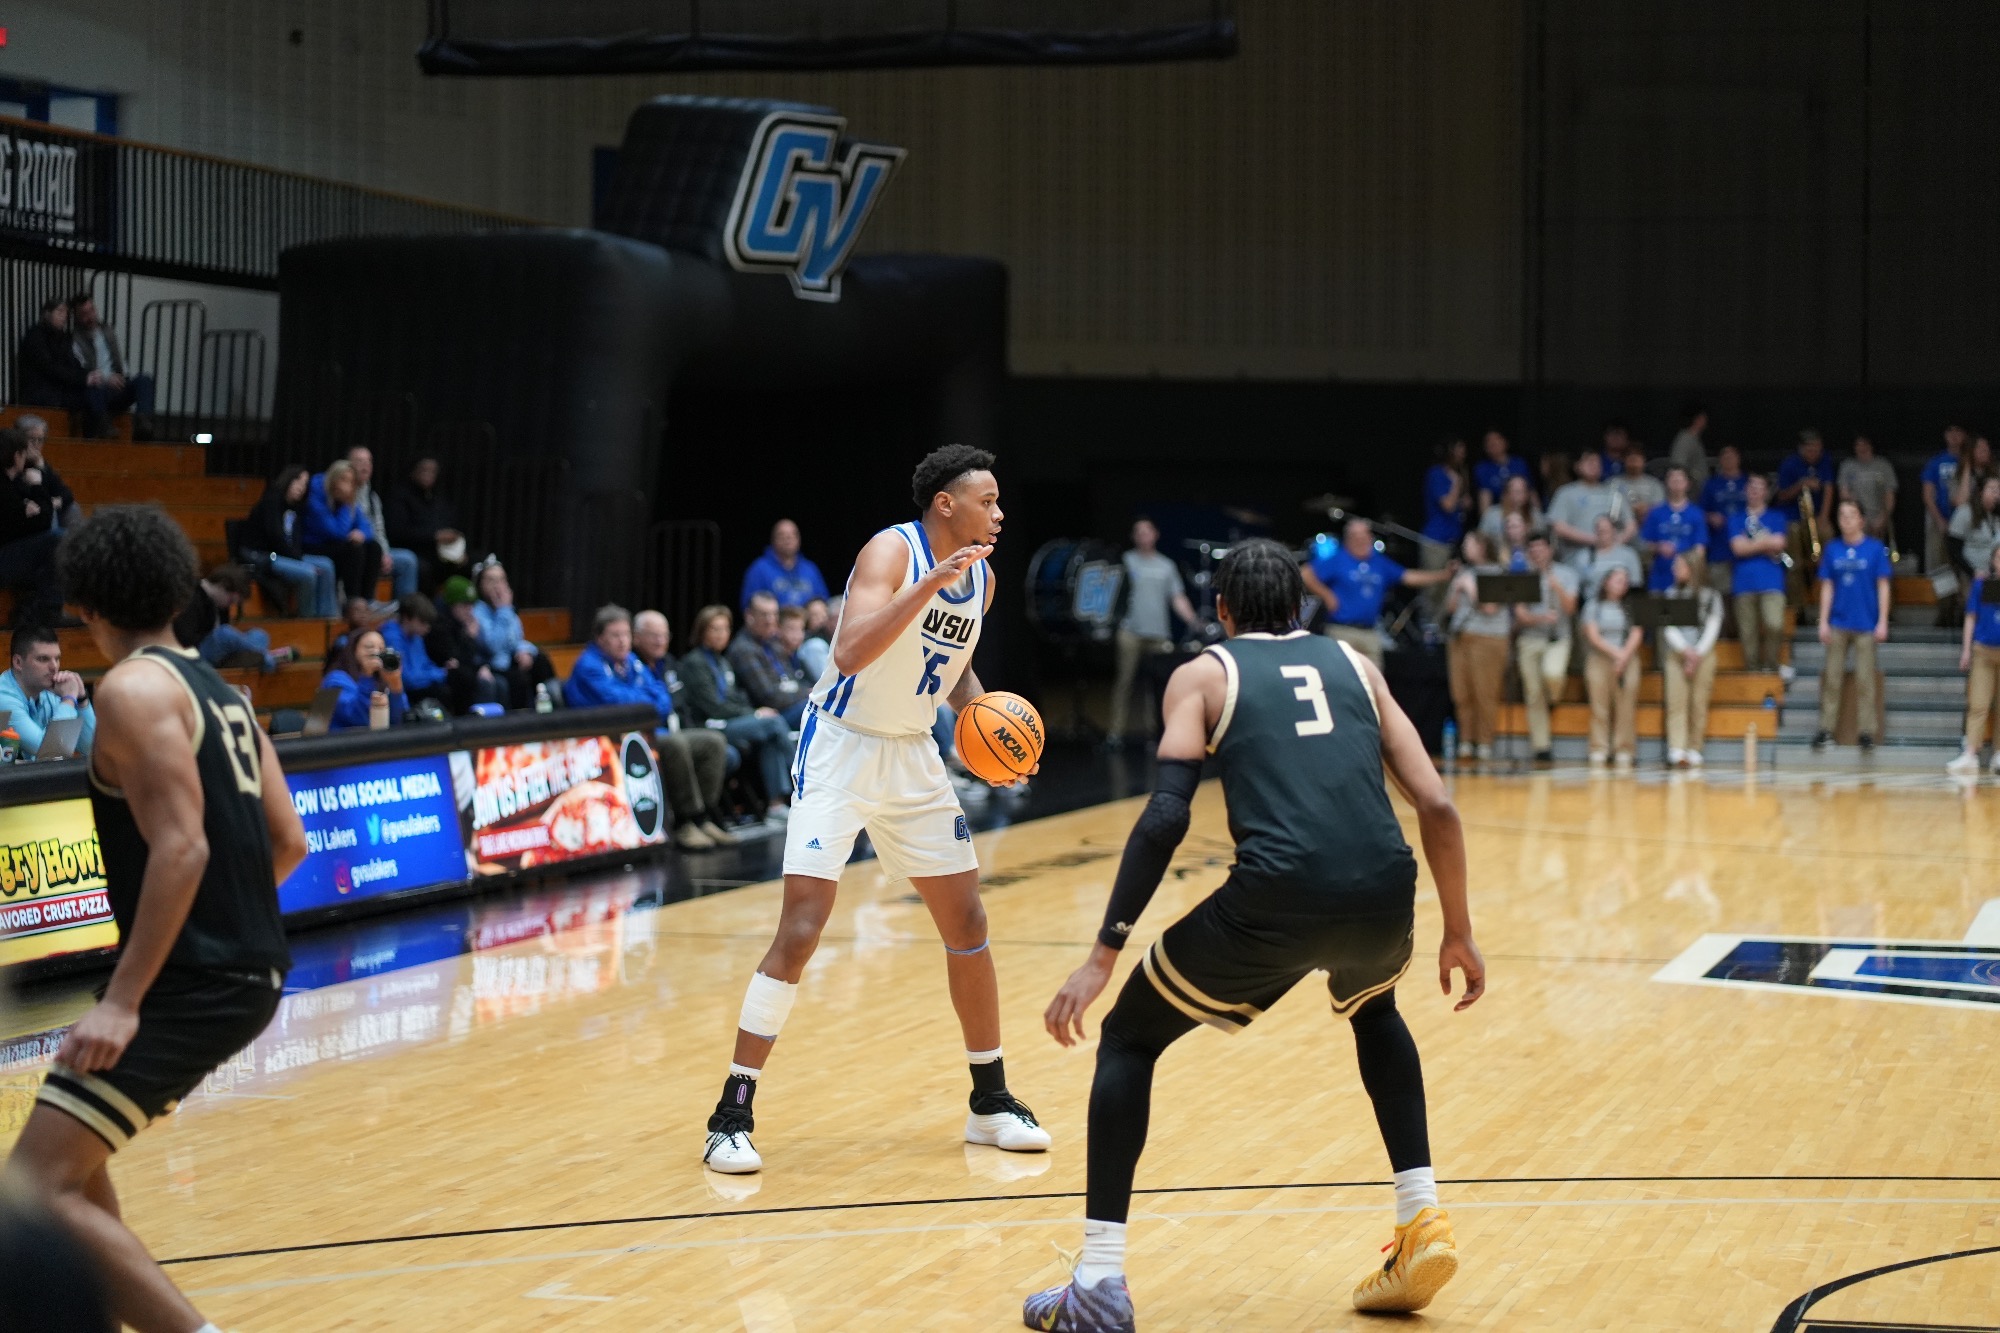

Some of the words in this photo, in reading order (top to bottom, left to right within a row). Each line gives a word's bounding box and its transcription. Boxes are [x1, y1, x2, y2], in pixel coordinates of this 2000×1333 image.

[17, 138, 77, 218] ROAD
[1280, 665, 1334, 737] 3
[1006, 700, 1043, 751] Wilson
[993, 726, 1028, 764] NCAA
[319, 786, 339, 813] US
[338, 782, 359, 810] ON
[357, 777, 402, 807] SOCIAL
[400, 771, 442, 800] MEDIA
[305, 829, 324, 854] SU
[322, 826, 358, 851] Lakers
[380, 813, 441, 845] @gvsulakers
[351, 857, 398, 888] gvsulakers
[78, 895, 111, 917] PIZZA
